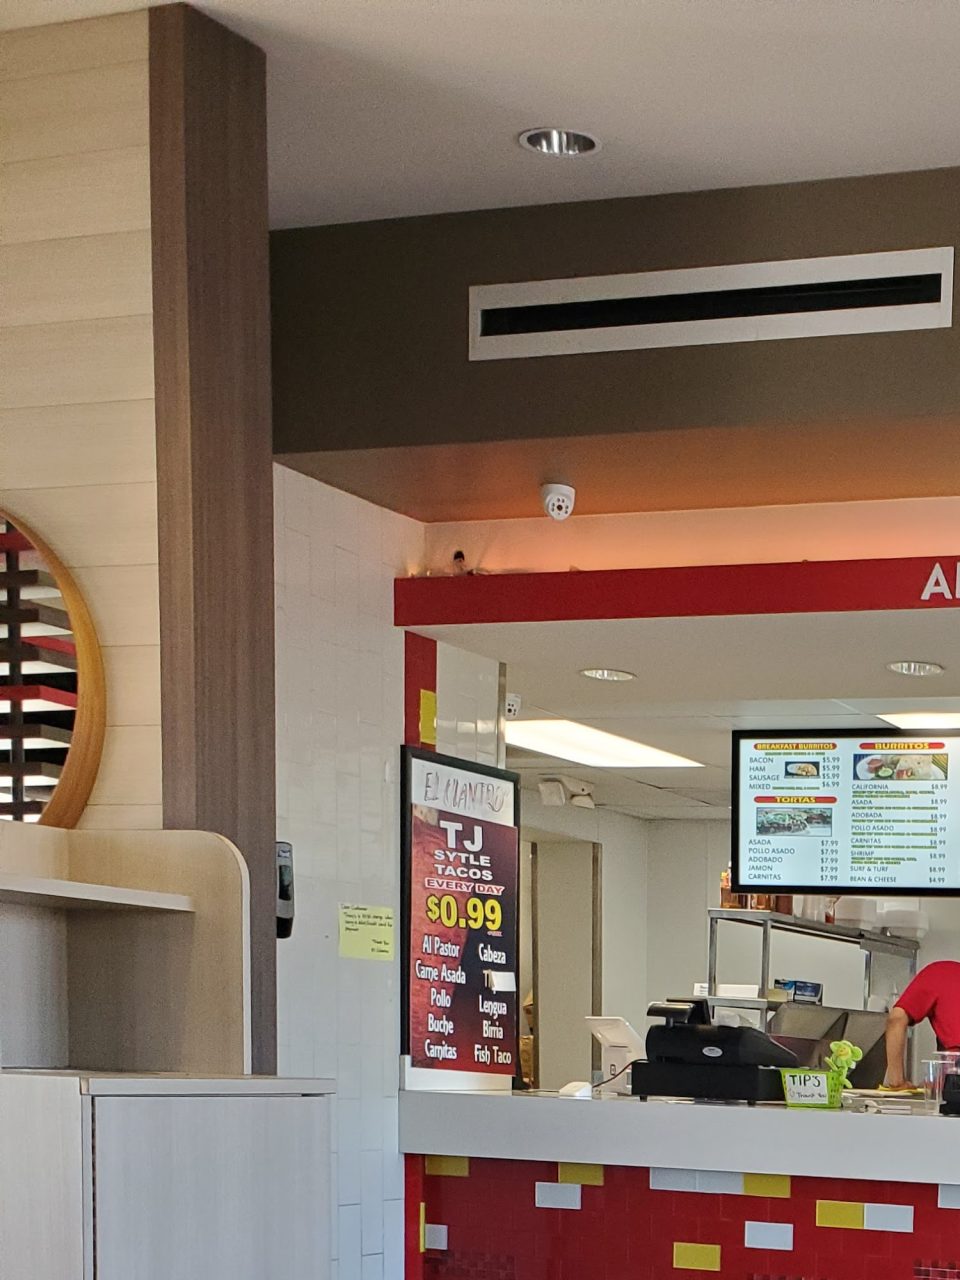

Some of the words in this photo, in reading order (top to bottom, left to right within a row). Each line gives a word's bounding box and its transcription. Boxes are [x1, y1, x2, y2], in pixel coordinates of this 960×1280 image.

[439, 820, 484, 852] TJ
[434, 851, 492, 867] SYTLE
[434, 865, 493, 881] TACOS
[426, 879, 474, 892] EVERY
[476, 884, 504, 895] DAY
[426, 894, 503, 931] $0.99
[423, 934, 432, 954] Al
[434, 936, 460, 957] Pastor
[479, 943, 507, 964] Cabeza
[416, 960, 438, 981] Carne
[441, 963, 466, 984] Asada
[431, 988, 451, 1008] Pollo
[479, 994, 508, 1019] Lengua
[428, 1013, 454, 1035] Buche
[483, 1020, 504, 1039] Birria
[425, 1039, 457, 1060] Carnitas
[474, 1044, 490, 1065] Fish
[492, 1046, 512, 1064] Taco
